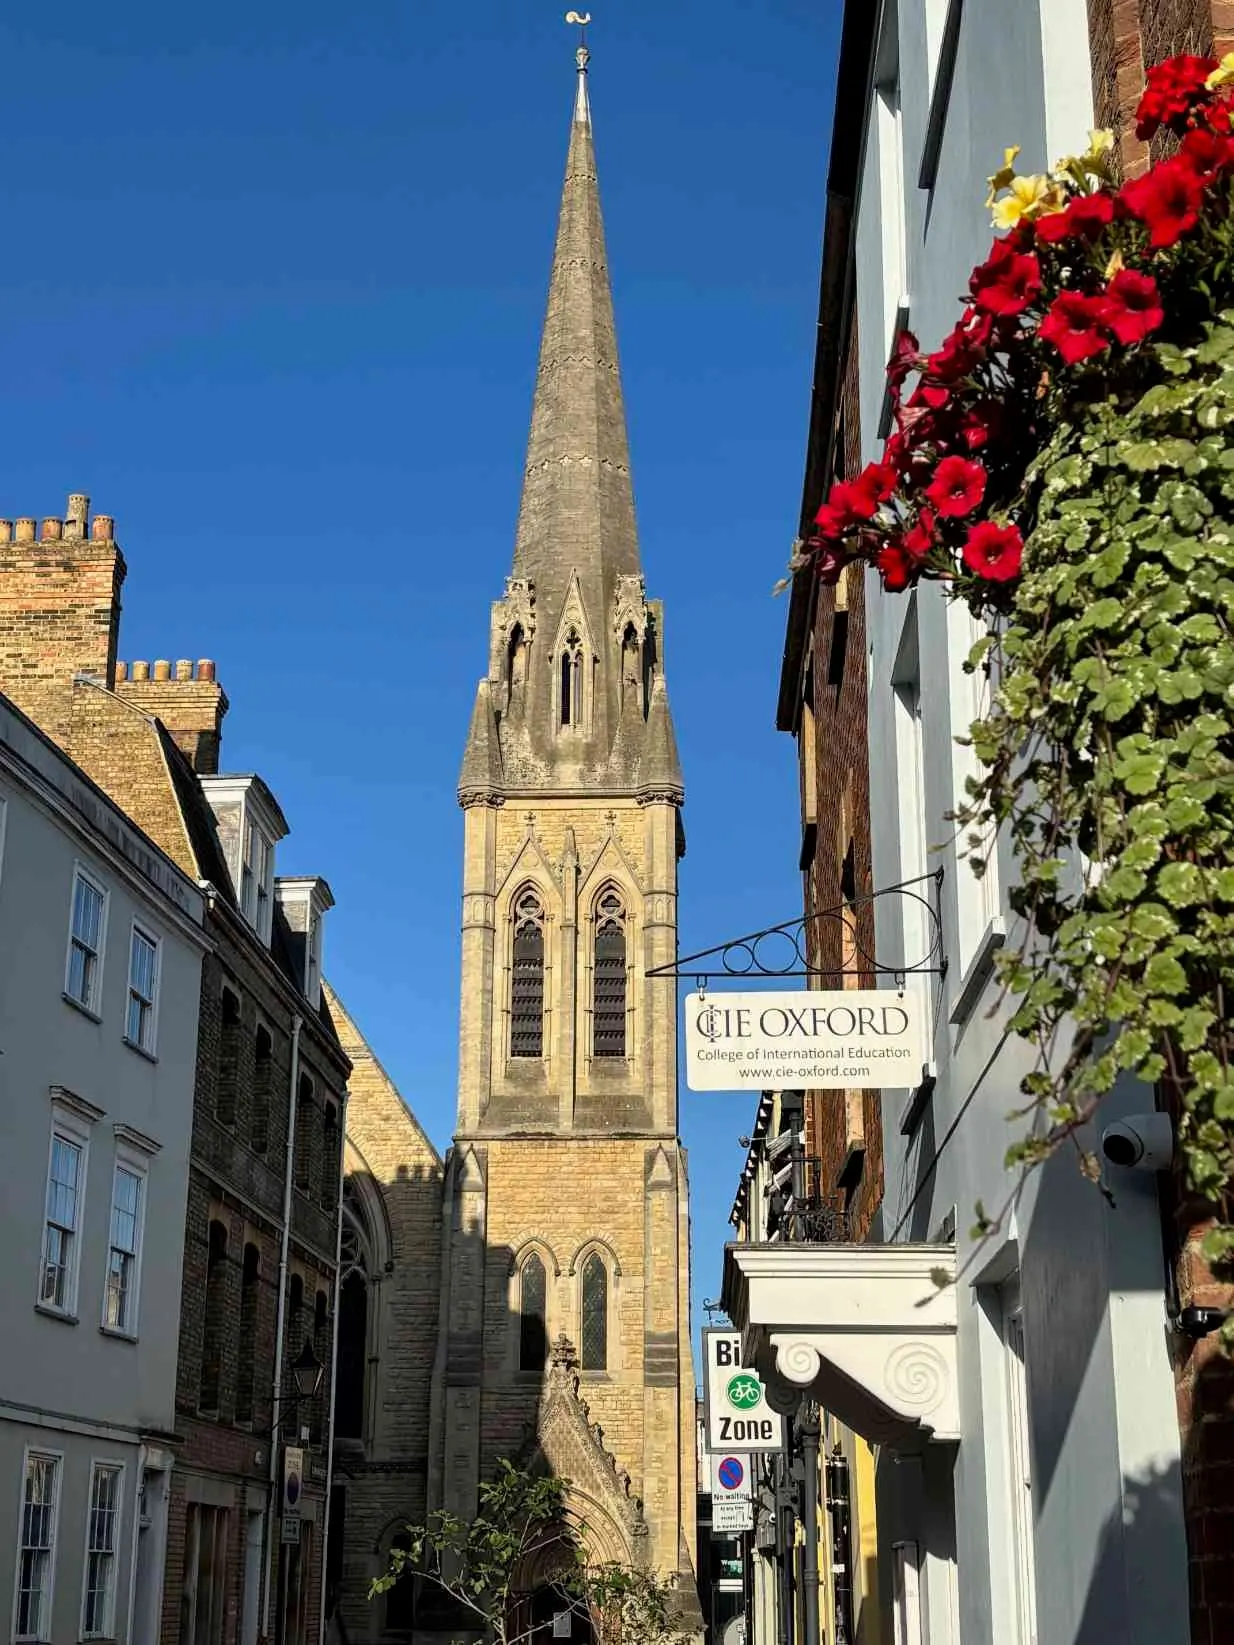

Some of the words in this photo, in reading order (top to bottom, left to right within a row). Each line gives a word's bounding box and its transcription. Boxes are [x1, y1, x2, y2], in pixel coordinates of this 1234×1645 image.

[696, 1004, 752, 1042] CIE
[760, 1007, 909, 1037] OXFORD
[697, 1049, 743, 1062] College
[746, 1048, 760, 1060] of
[763, 1047, 844, 1060] International
[848, 1047, 911, 1058] Education
[739, 1065, 870, 1078] www.cie-oxford.com
[716, 1340, 740, 1366] Bi
[719, 1417, 772, 1440] Zone
